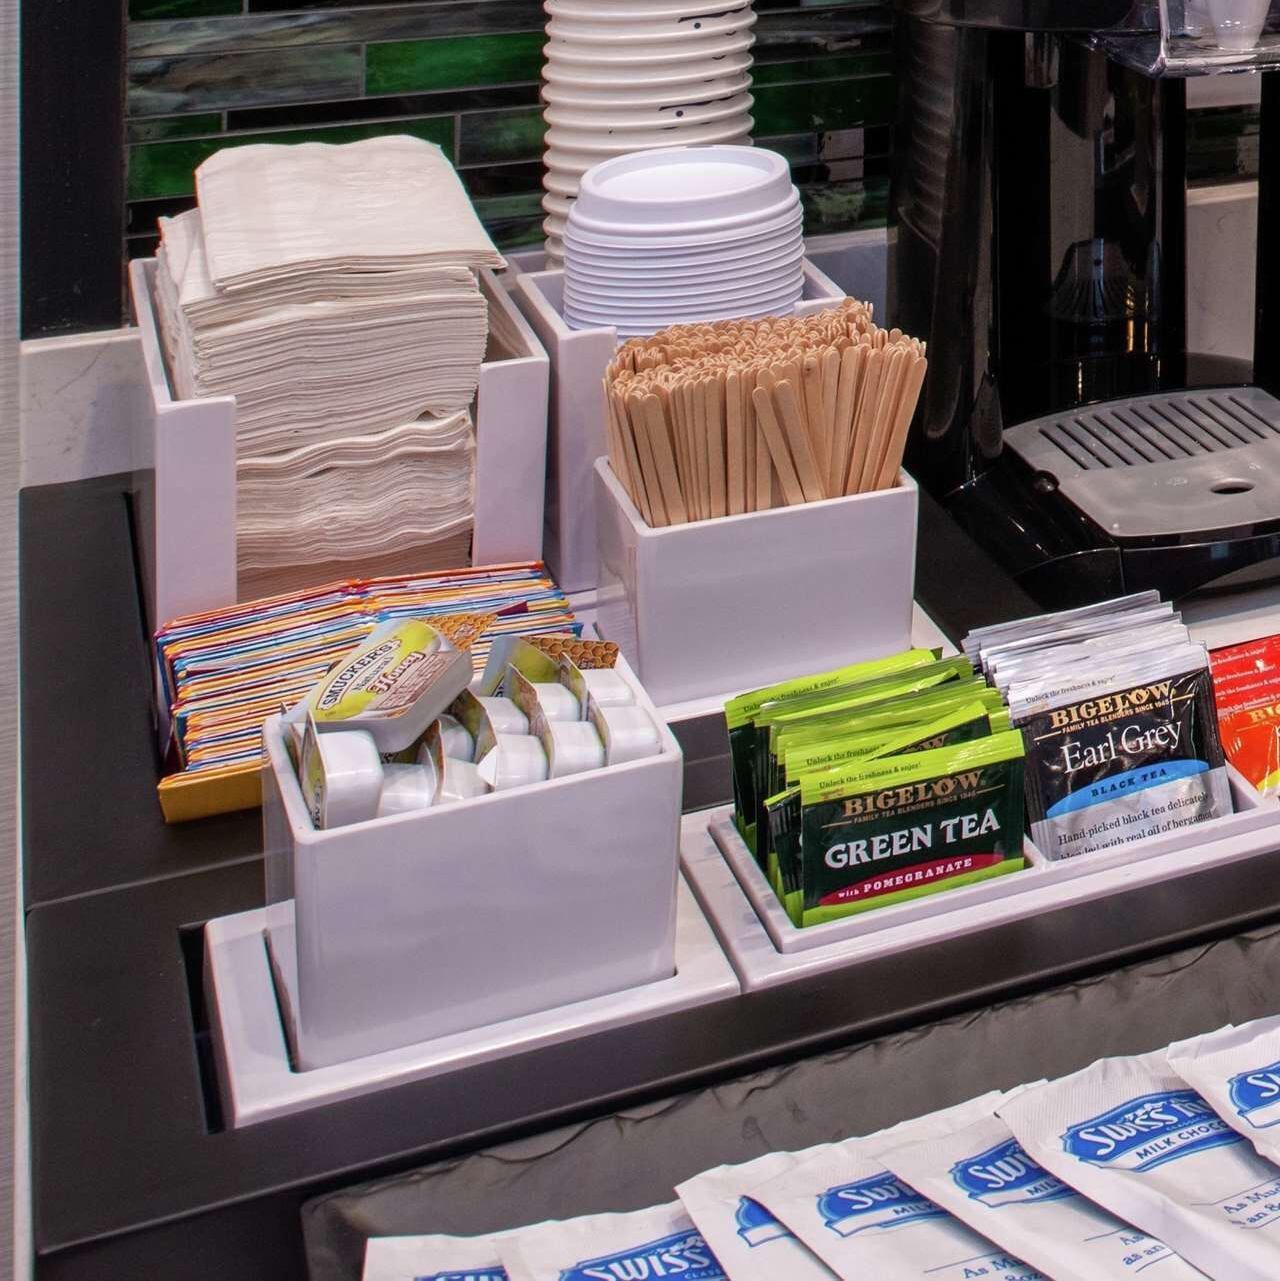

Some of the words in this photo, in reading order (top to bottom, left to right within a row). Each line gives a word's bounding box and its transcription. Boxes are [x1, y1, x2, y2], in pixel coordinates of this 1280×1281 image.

[366, 650, 426, 695] Honey
[1049, 679, 1173, 729] BIGELOW
[1062, 722, 1085, 734] FAMILY
[1086, 718, 1100, 729] TEA
[1100, 708, 1134, 725] BLENDERS
[1135, 703, 1154, 714] SINCE
[1059, 732, 1118, 774] Earl
[1121, 721, 1182, 755] Grey
[819, 776, 845, 789] Unlock
[846, 774, 857, 784] the
[843, 769, 984, 818] BIGELOW
[1091, 778, 1136, 798] BLACK
[1142, 768, 1167, 782] TEA
[854, 814, 880, 824] FAMILY
[881, 810, 895, 818] TEA
[897, 800, 935, 815] BLENDERS
[937, 795, 959, 807] SINCE
[1058, 818, 1121, 846] Hand-picked
[1121, 810, 1150, 826] black
[1151, 804, 1166, 816] tea
[824, 823, 932, 869] GREEN
[940, 808, 1000, 844] TEA
[1147, 823, 1161, 837] oil
[1162, 819, 1172, 832] of
[838, 888, 860, 898] with
[863, 858, 973, 894] POMEGRANATE
[1135, 1137, 1174, 1161] MILK
[1223, 1202, 1248, 1215] As
[1246, 1212, 1268, 1223] an
